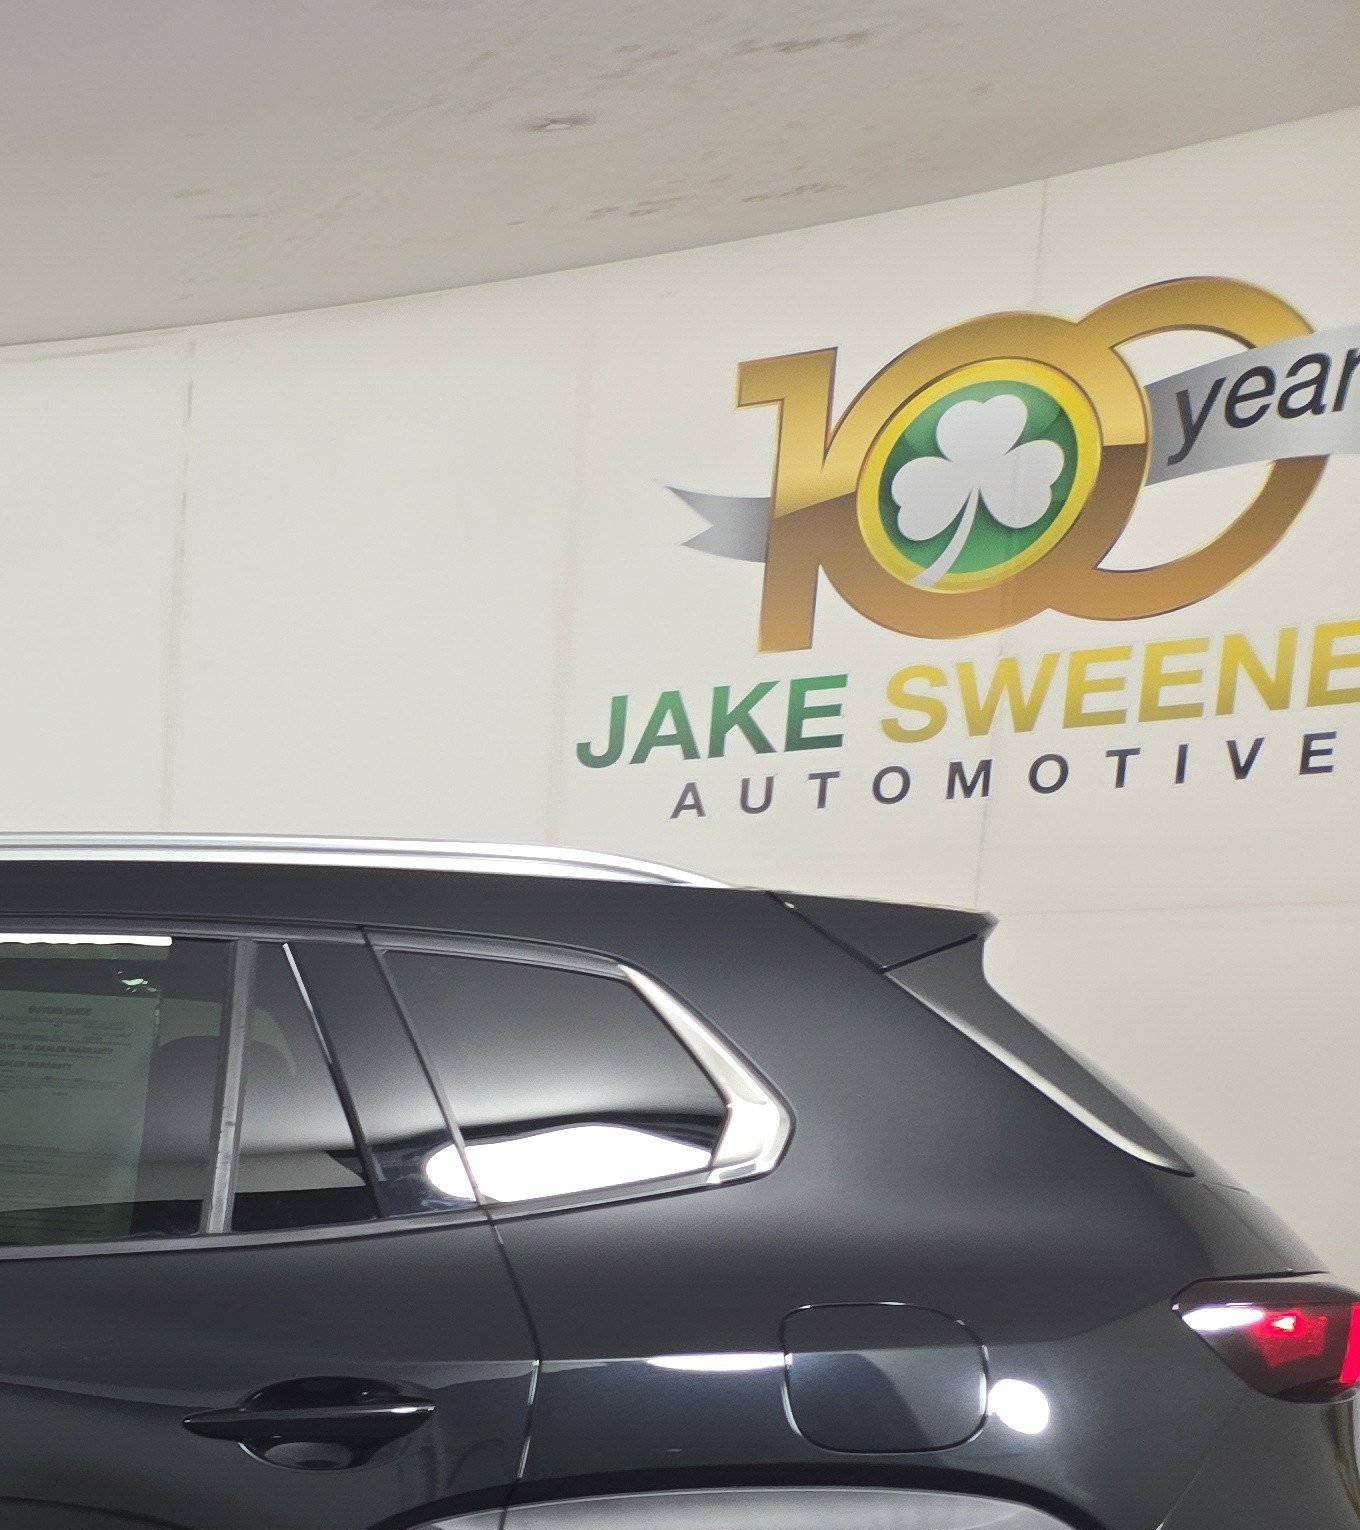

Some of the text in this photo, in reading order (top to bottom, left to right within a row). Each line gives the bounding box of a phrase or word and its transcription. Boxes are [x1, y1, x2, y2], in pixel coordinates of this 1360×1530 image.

[736, 276, 1360, 653] 100 year
[576, 619, 1360, 769] JAKE SWEENE
[669, 730, 1339, 821] AUTOMOTIVE
